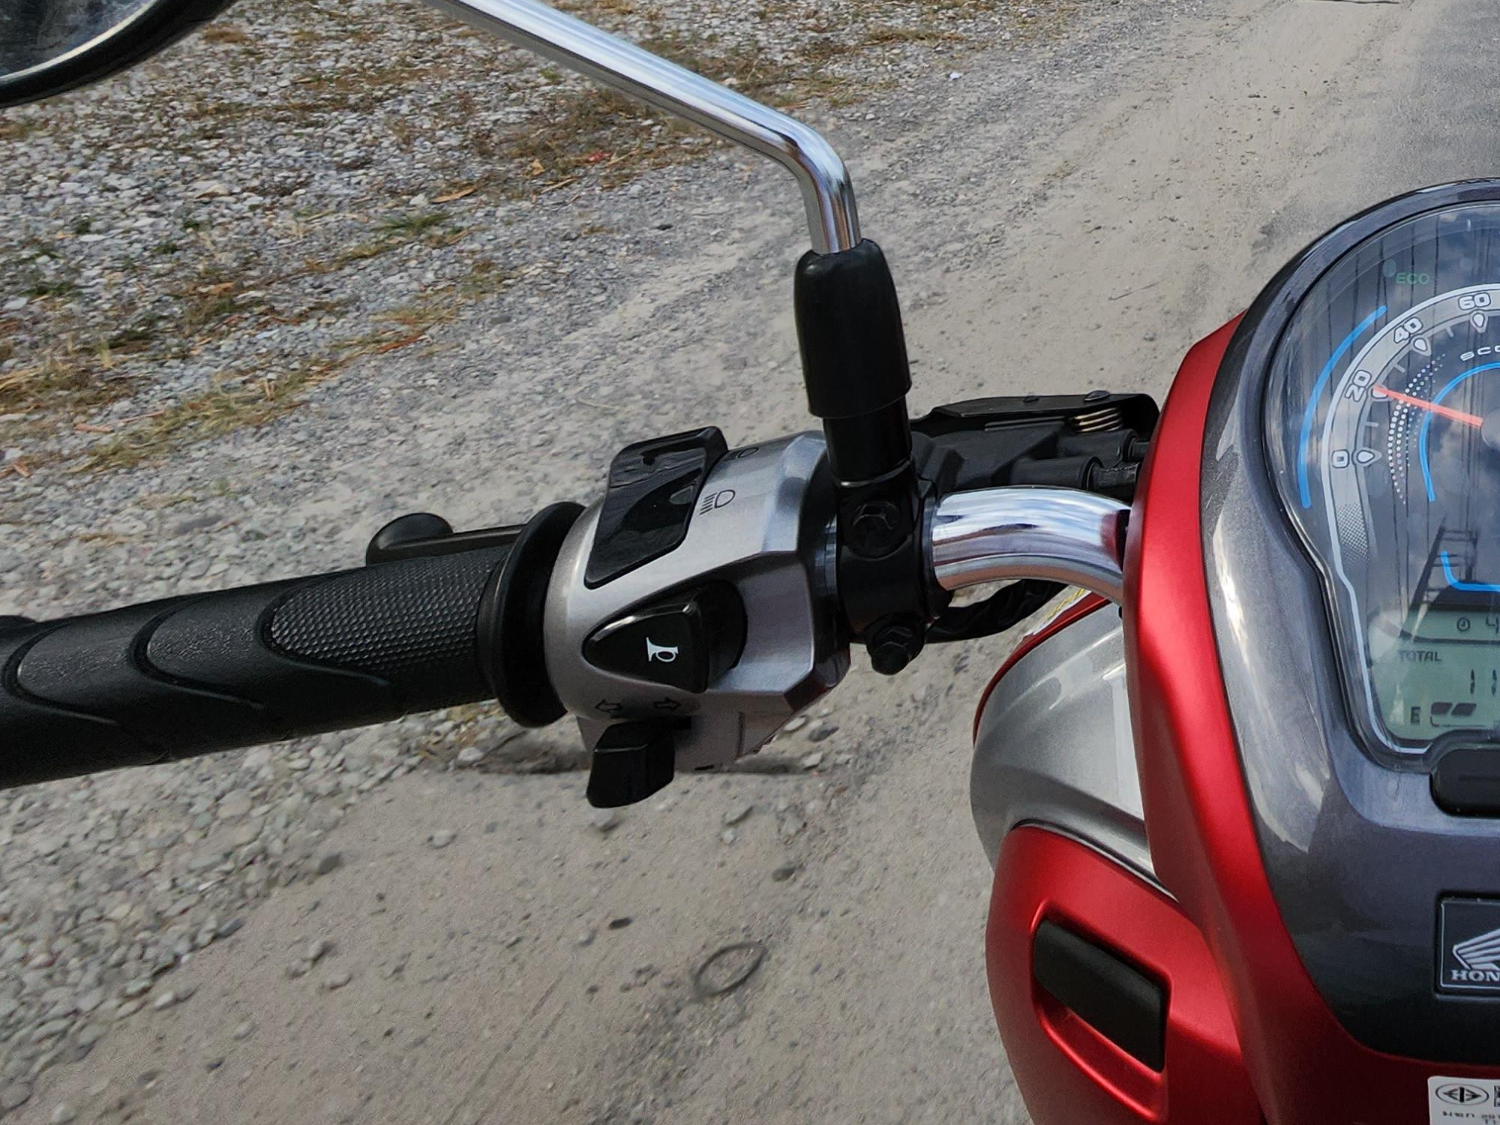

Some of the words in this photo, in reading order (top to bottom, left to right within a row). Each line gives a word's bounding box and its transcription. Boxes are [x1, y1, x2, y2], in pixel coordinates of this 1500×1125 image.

[1395, 272, 1430, 285] ECO
[1459, 292, 1491, 310] 60
[1394, 317, 1423, 344] 40
[1345, 370, 1372, 402] 20
[1332, 448, 1350, 468] 0
[1398, 649, 1442, 662] TOTAL
[1410, 706, 1421, 724] E
